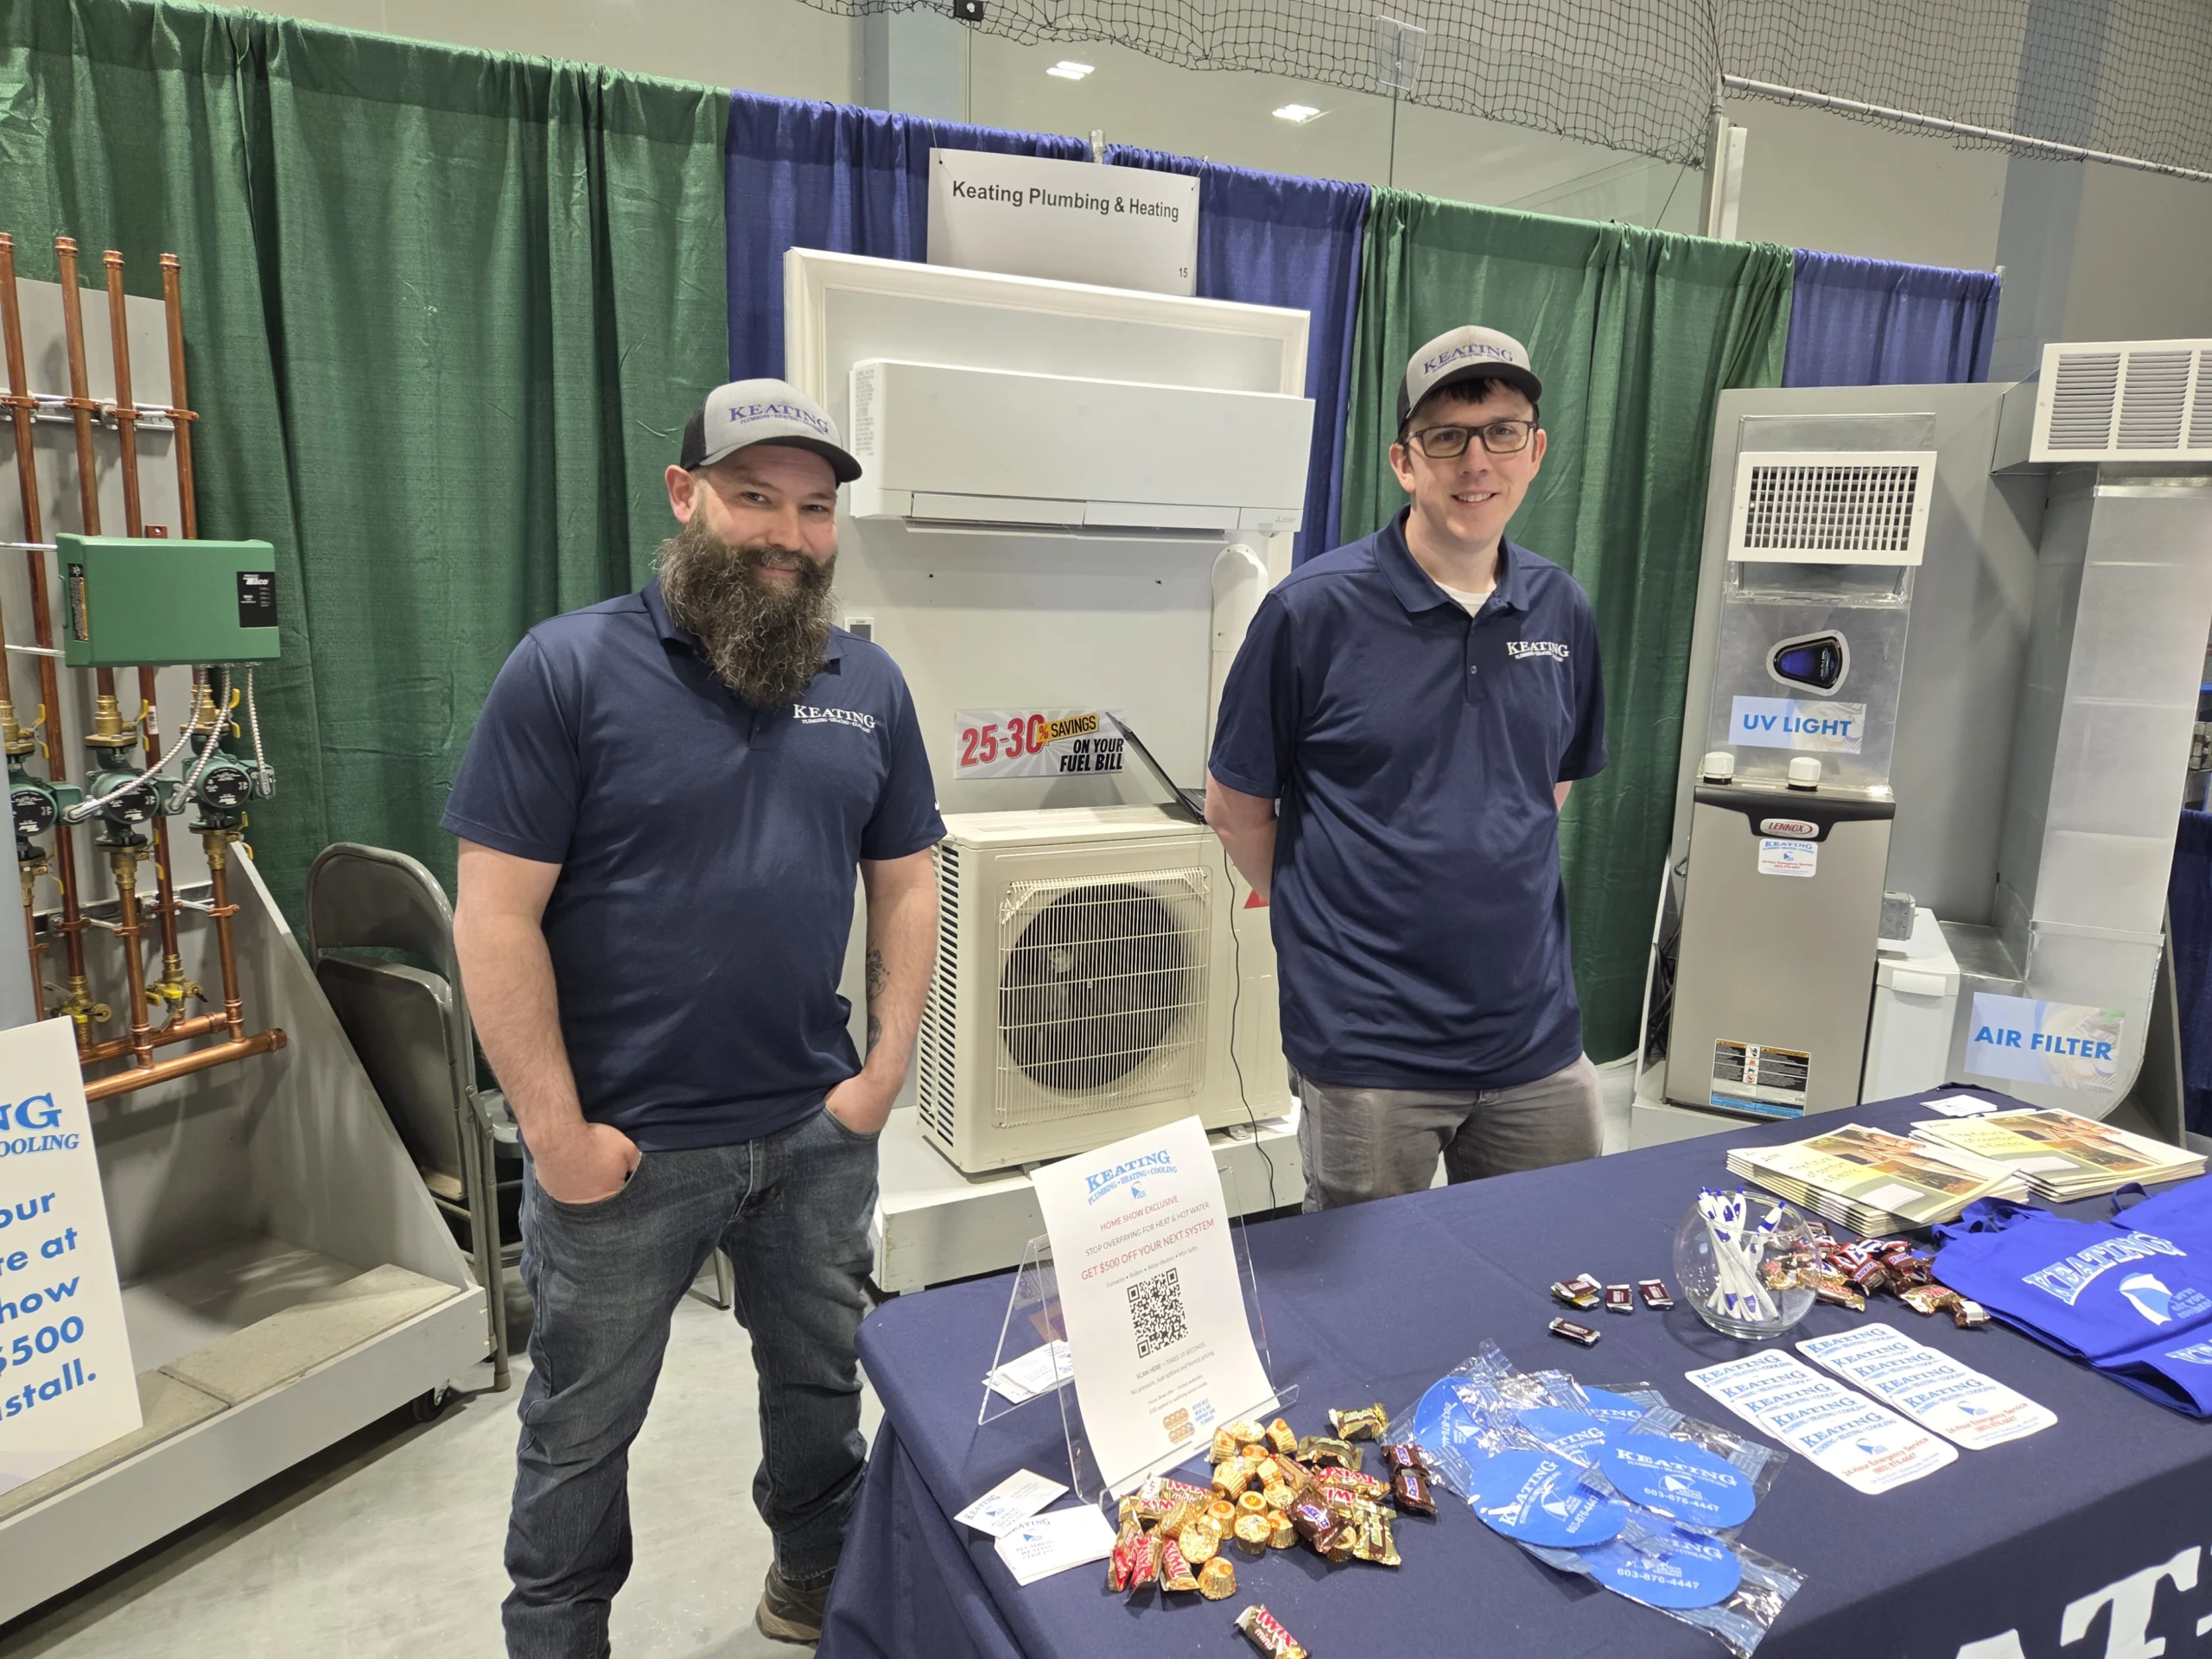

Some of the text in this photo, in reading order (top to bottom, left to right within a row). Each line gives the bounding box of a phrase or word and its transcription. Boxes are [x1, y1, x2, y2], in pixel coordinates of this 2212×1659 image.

[952, 181, 1179, 222] Keating Plumbing & Heating
[1179, 267, 1188, 278] 15
[1423, 344, 1513, 374] KEATING
[728, 404, 829, 433] KEATING
[1506, 641, 1569, 657] KEATING
[793, 704, 875, 728] KEATING
[1052, 715, 1096, 738] SAVINGS
[1743, 714, 1852, 736] UV LIGHT
[1073, 738, 1123, 753] ON YOUR
[1059, 753, 1122, 772] FUEL BILL
[1768, 822, 1804, 833] LENNOX
[1974, 1026, 2112, 1060] AIR FILTER
[1084, 1149, 1170, 1194] KEATING
[1087, 1166, 1177, 1206] PLUMBING HEATING COOLING
[1100, 1217, 1122, 1231] HOME
[1122, 1208, 1144, 1224] SHOW
[1145, 1195, 1179, 1215] EXCLUSIVE
[41, 1227, 78, 1259] at
[1085, 1244, 1103, 1257] STOP
[1103, 1229, 1142, 1250] OVERPAYING
[1142, 1223, 1155, 1235] FOR
[1155, 1217, 1170, 1230] HEAT
[1177, 1210, 1189, 1219] HOT
[1190, 1202, 1210, 1215] WATER
[1082, 1218, 1214, 1281] GET $500 OFF YOUR NEXT SYSTEM
[1107, 1276, 1125, 1287] Furnaces
[2021, 1230, 2188, 1306] KEATING
[1806, 1328, 1887, 1353] KEATING
[1831, 1342, 1910, 1368] KEATING
[1136, 1370, 1149, 1380] SCAN
[1149, 1363, 1161, 1374] HERE
[1695, 1354, 1782, 1382] KEATING
[1853, 1352, 1934, 1377] KEATING
[1719, 1370, 1808, 1398] KEATING
[1876, 1365, 1957, 1394] KEATING
[1902, 1378, 1984, 1408] KEATING
[1744, 1382, 1831, 1413] KEATING
[1770, 1397, 1857, 1427] KEATING
[1799, 1412, 1884, 1448] KEATING
[1869, 1448, 1903, 1467] Emergency
[1903, 1436, 1929, 1452] Service
[1615, 1447, 1738, 1486] KEATING
[963, 1494, 1001, 1521] KEATING
[1498, 1460, 1558, 1527] KATING
[1643, 1487, 1719, 1512] 603-876-4447
[1617, 1567, 1700, 1590] 603-876-4447
